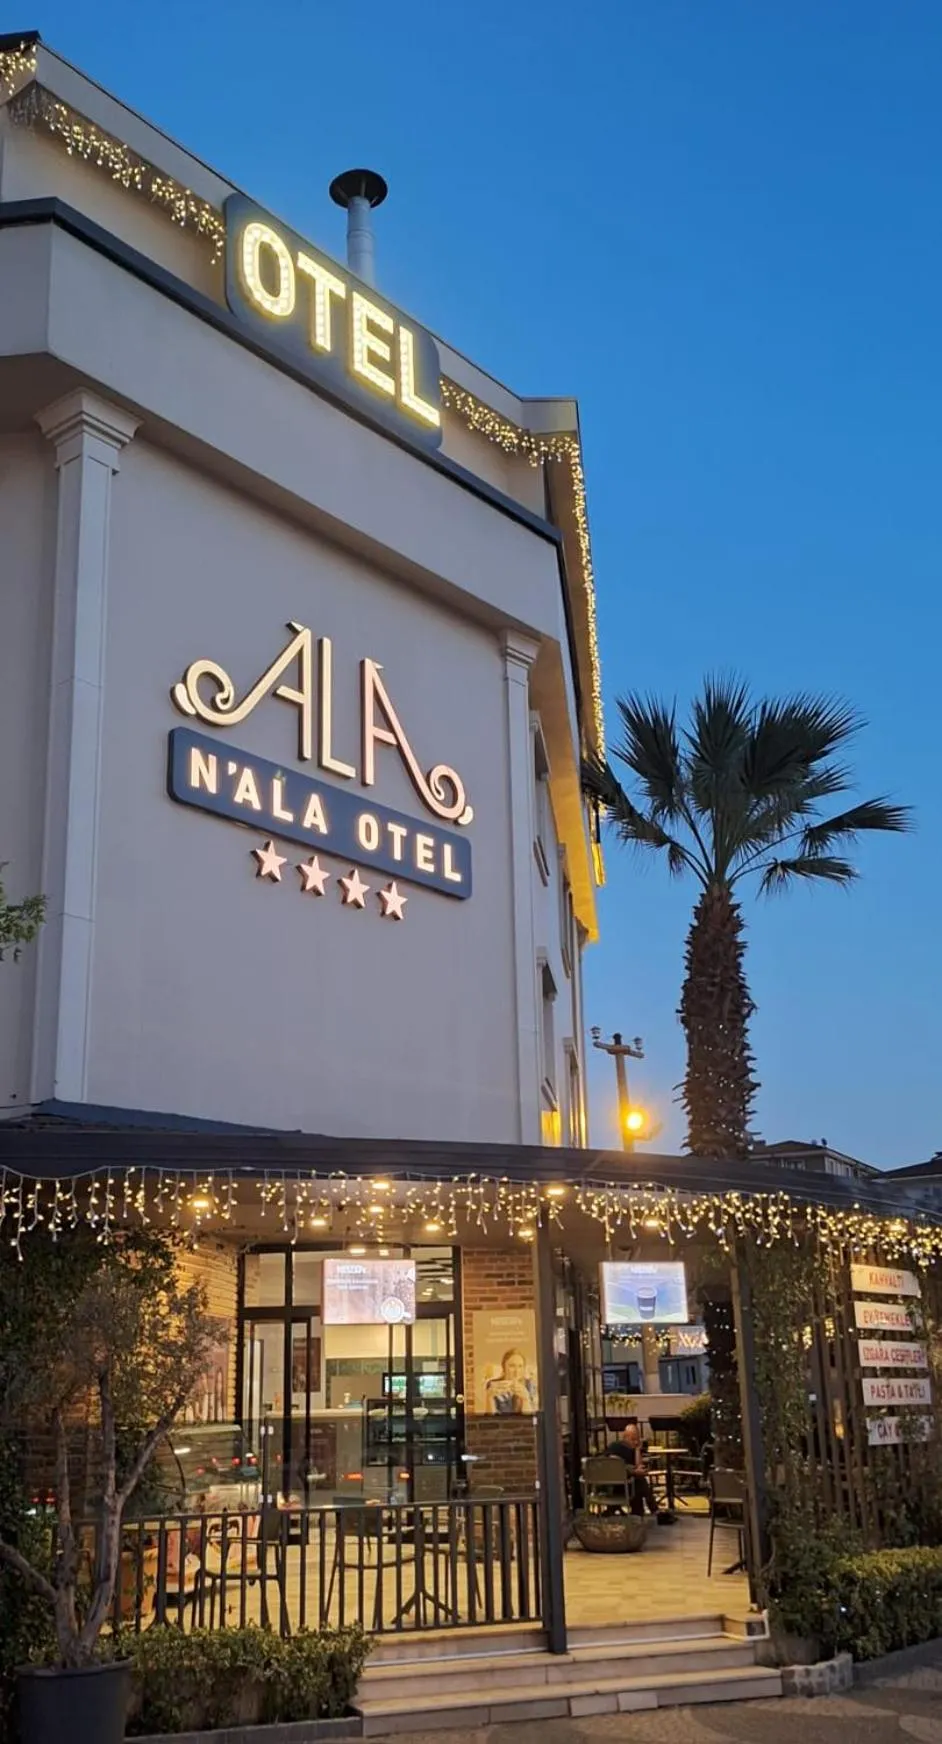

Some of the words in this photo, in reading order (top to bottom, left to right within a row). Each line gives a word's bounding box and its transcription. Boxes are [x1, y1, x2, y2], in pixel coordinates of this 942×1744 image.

[242, 222, 440, 427] OTEL
[190, 747, 328, 835] N'ALA
[358, 813, 462, 882] OTEL
[870, 1384, 895, 1399] PASTA
